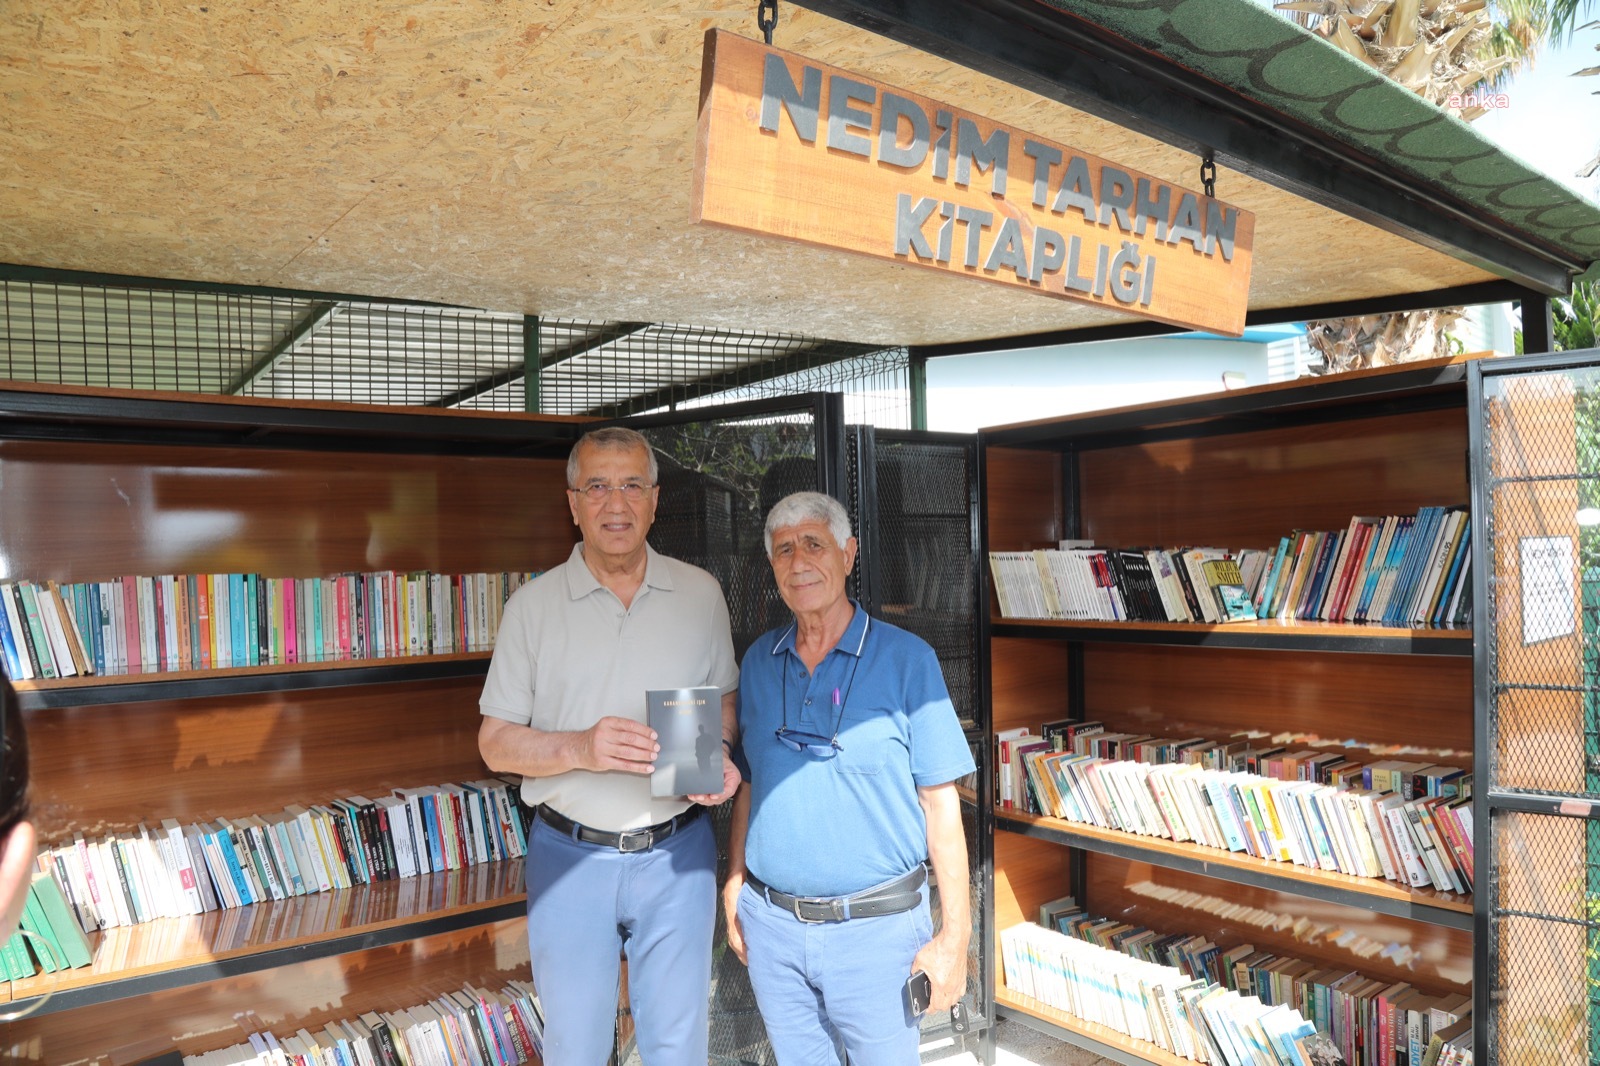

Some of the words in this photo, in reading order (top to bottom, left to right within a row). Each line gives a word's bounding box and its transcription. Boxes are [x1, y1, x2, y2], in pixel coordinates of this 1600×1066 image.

[759, 52, 1010, 199] NEDİM
[1024, 140, 1238, 262] TARHAN
[893, 193, 1156, 306] KİTAPLIĞI
[1217, 572, 1243, 584] SMITH
